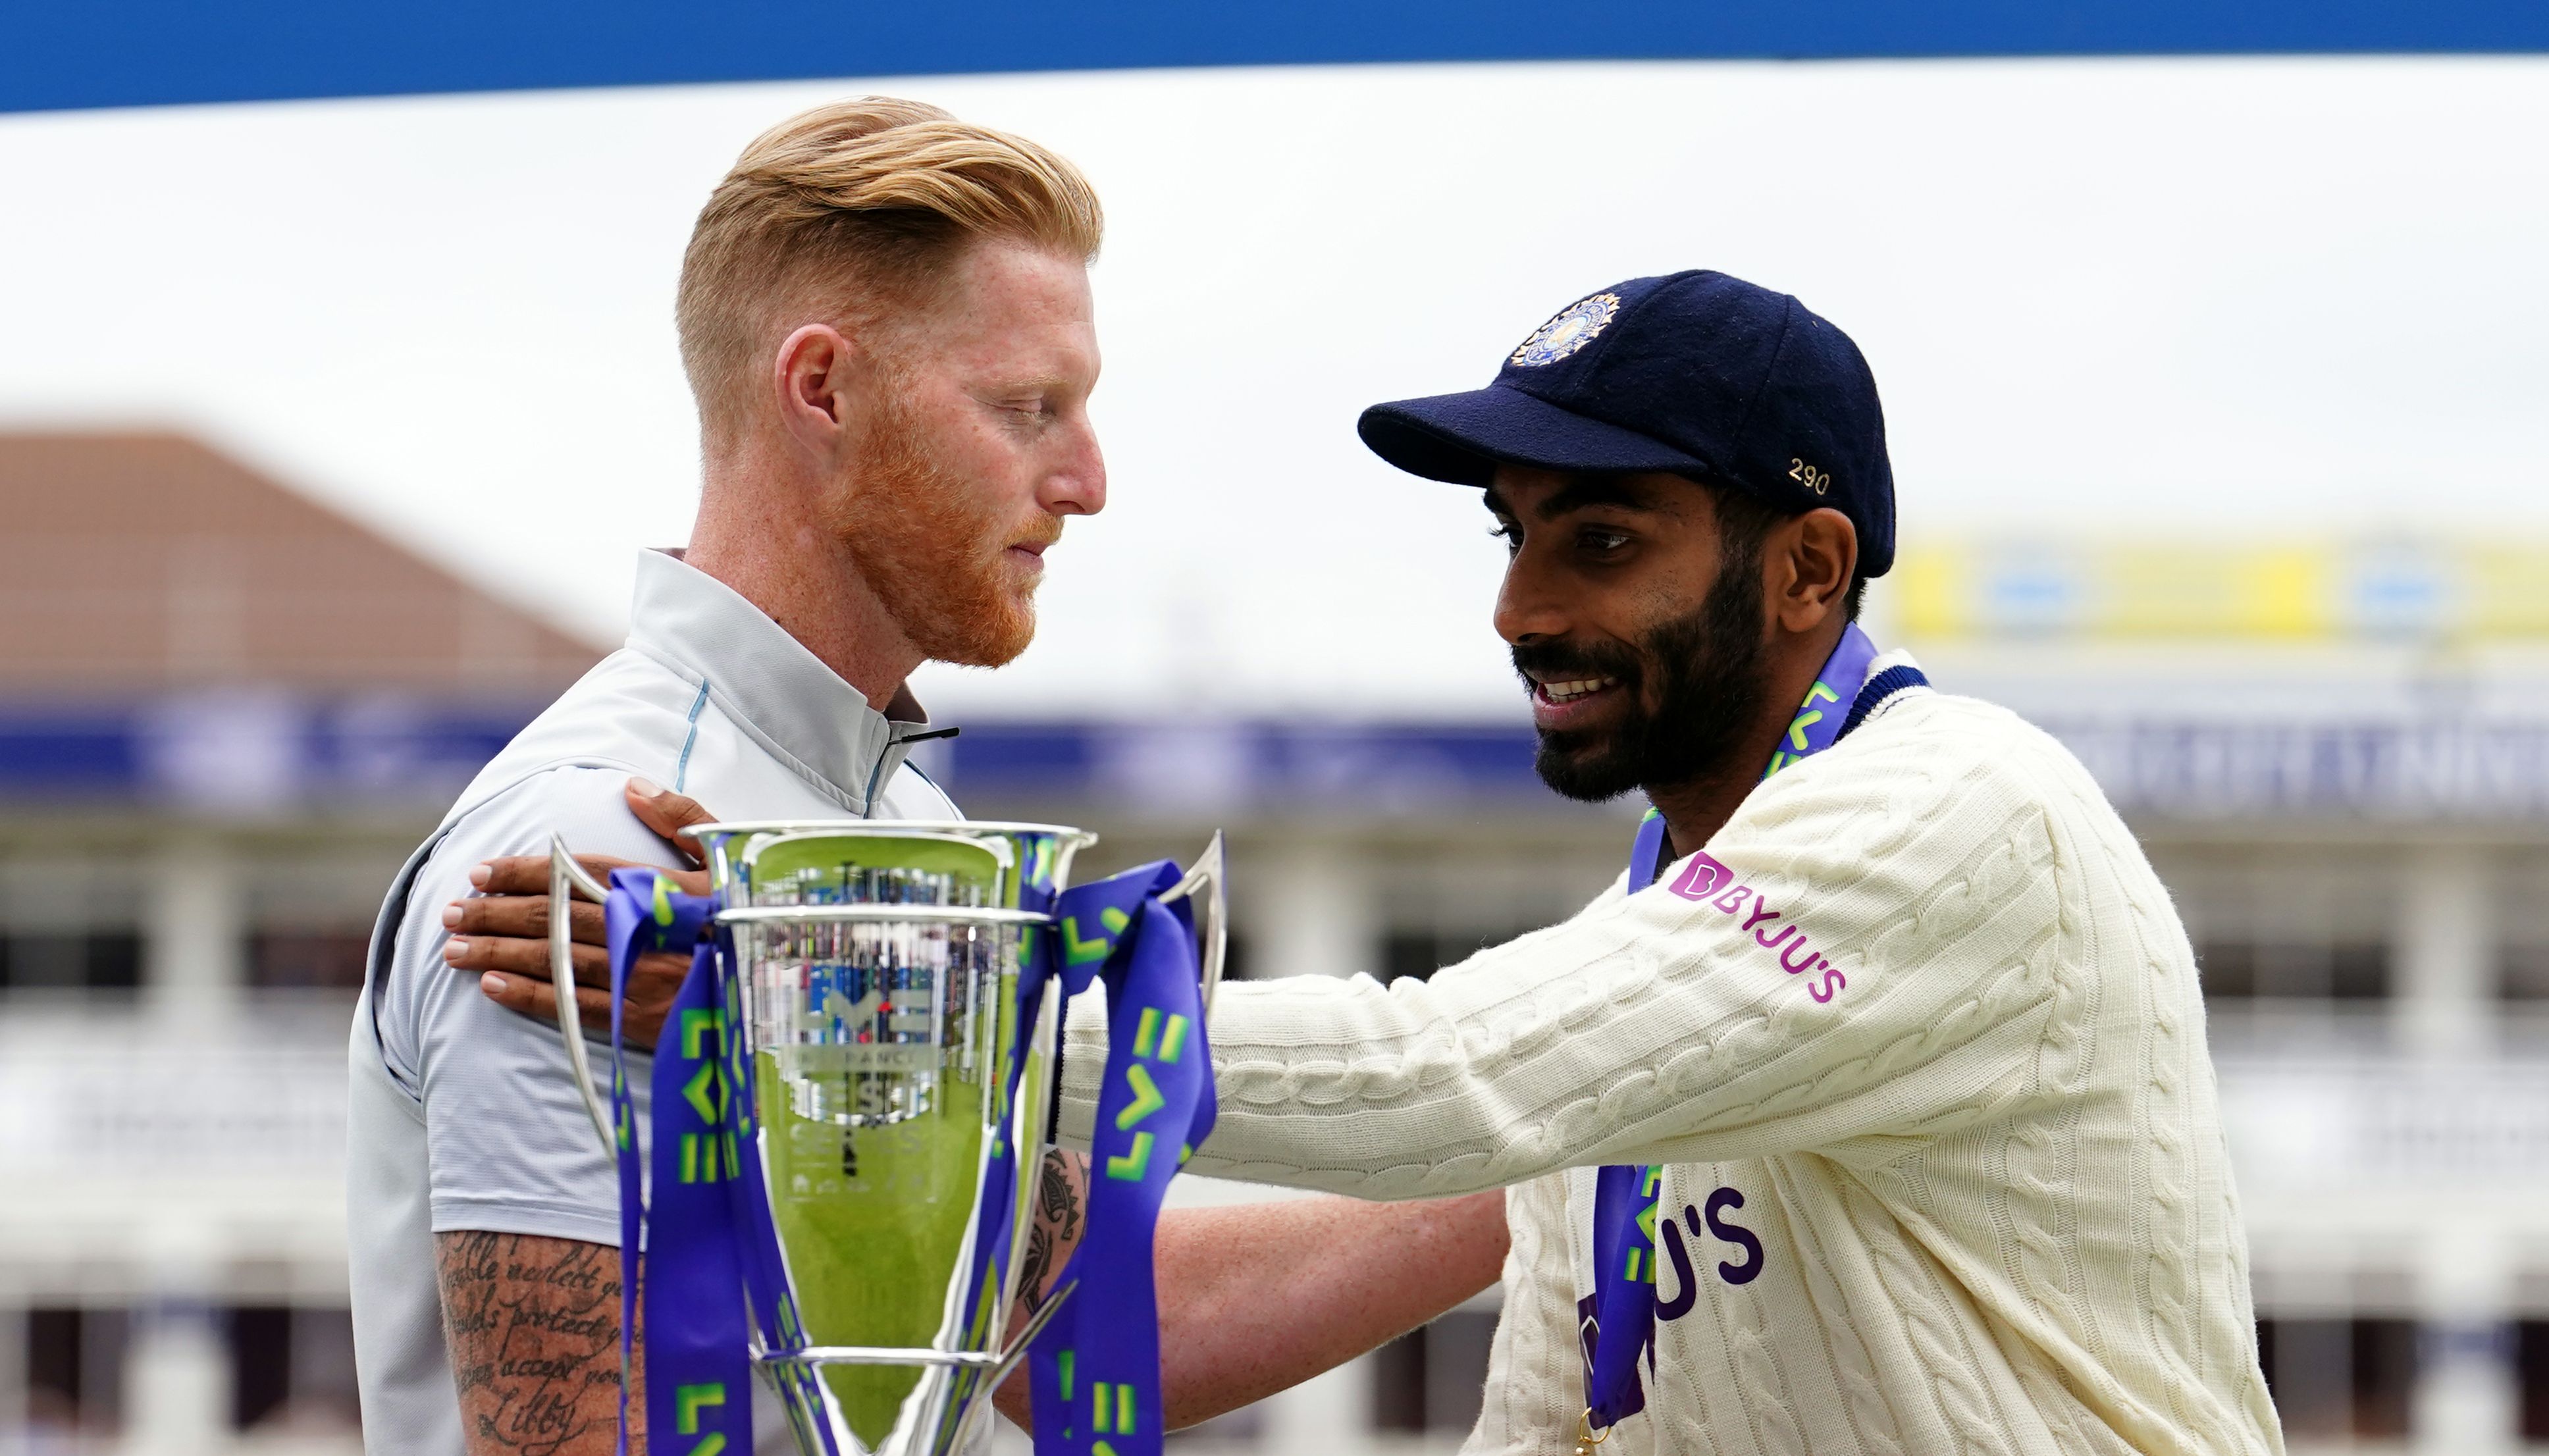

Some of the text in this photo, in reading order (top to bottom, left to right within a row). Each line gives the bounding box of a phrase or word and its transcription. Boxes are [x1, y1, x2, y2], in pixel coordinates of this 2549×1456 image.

[1788, 458, 1830, 496] 290
[1712, 885, 1846, 1004] BYJU'S
[479, 1387, 591, 1456] Libby
